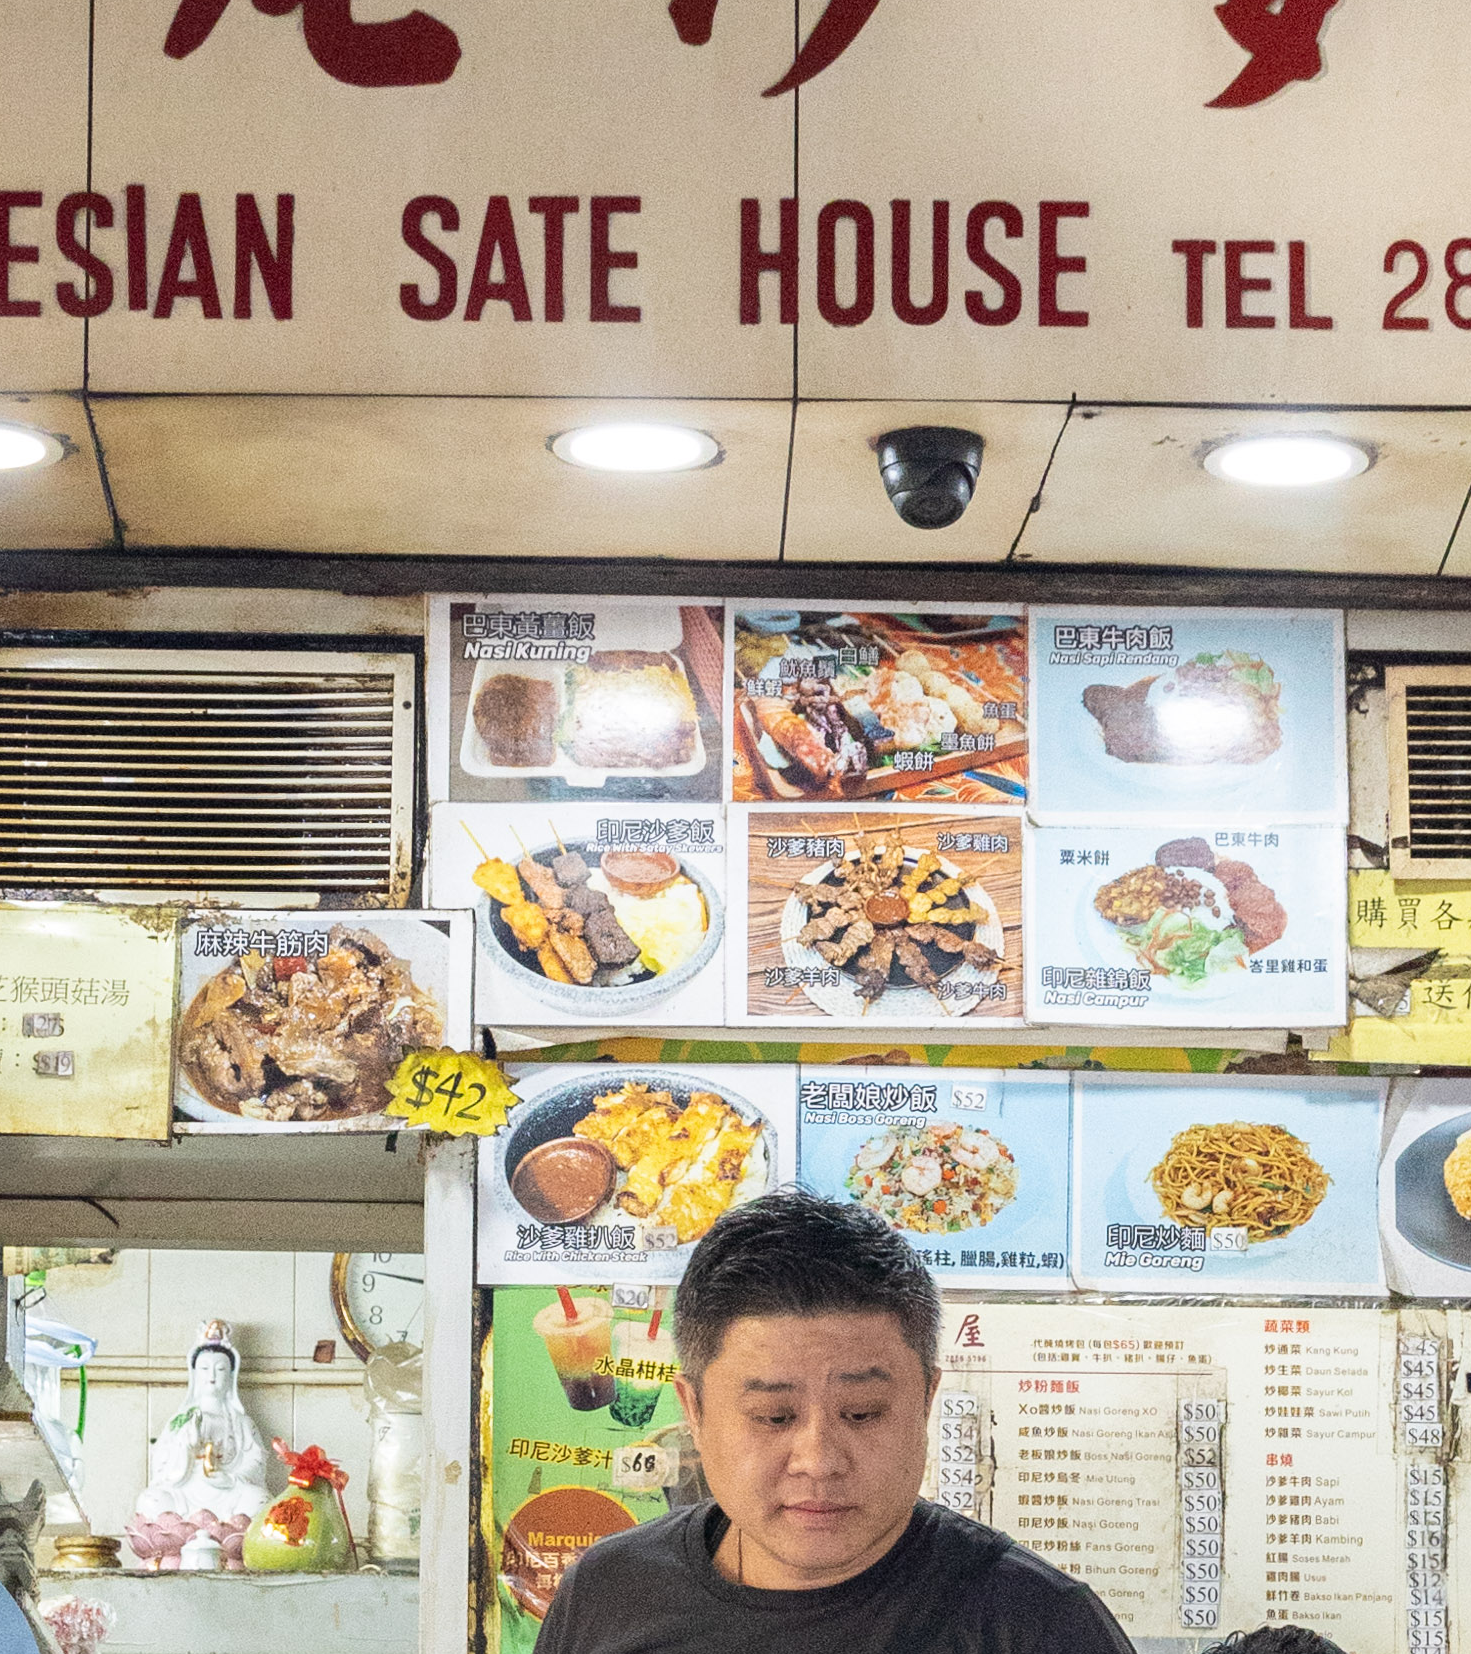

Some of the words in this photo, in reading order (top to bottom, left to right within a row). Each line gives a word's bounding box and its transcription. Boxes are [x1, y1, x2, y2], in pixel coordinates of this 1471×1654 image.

[399, 195, 642, 324] SATE
[738, 198, 1091, 327] HOUSE
[1172, 237, 1334, 330] TEL
[462, 611, 595, 641] 巴東黃薑飯
[1054, 625, 1174, 651] 巴東牛肉飯
[462, 641, 513, 661] Nasi
[514, 642, 592, 663] Kuning
[838, 645, 881, 667] 白鱔
[1049, 651, 1081, 666] Nasi
[1082, 651, 1115, 667] Sapi
[1116, 652, 1179, 668] Rendang
[746, 678, 783, 698] 鮮蝦
[982, 701, 1017, 720] 魚蛋
[940, 732, 996, 752] 墨魚餅
[893, 750, 934, 771] 蝦餅
[596, 818, 715, 843] 印尼沙爹飯
[1214, 831, 1279, 848] 巴東牛肉
[767, 836, 845, 858] 沙爹豬肉
[936, 832, 1009, 854] 沙爹雞肉
[1059, 848, 1110, 866] 粟米餅
[194, 928, 329, 958] 麻辣牛筋肉
[1249, 958, 1328, 974] 峇里雞和蛋
[764, 966, 841, 988] 沙爹羊肉
[1041, 965, 1151, 992] 印尼雜錦飯
[937, 981, 1007, 1002] 沙爹牛肉
[1043, 990, 1082, 1006] Nasi
[1083, 991, 1148, 1008] Campur
[410, 1064, 488, 1122] $42
[799, 1081, 937, 1114] 老闆娘炒飯
[952, 1089, 985, 1109] $52
[804, 1111, 836, 1126] Nasi
[837, 1111, 871, 1127] Boss
[873, 1113, 927, 1130] Goreng
[516, 1223, 637, 1251] 沙爹雞扒飯
[1106, 1224, 1207, 1251] 印尼炒麵
[1213, 1231, 1244, 1250] $50
[504, 1250, 530, 1263] Rice
[532, 1250, 560, 1263] With
[561, 1251, 610, 1263] Chicken
[611, 1251, 648, 1264] Steak
[1104, 1251, 1136, 1270] Mie
[1138, 1252, 1205, 1271] Goreng
[369, 1306, 382, 1324] 8
[955, 1314, 985, 1348] 屋
[1404, 1360, 1435, 1377] $45
[1018, 1380, 1080, 1394] 炒粉麵飯
[1183, 1403, 1216, 1420] $50
[508, 1438, 613, 1470] 印尼沙爹汁
[1266, 1453, 1293, 1467] 串燒
[1315, 1476, 1340, 1488] Sapi
